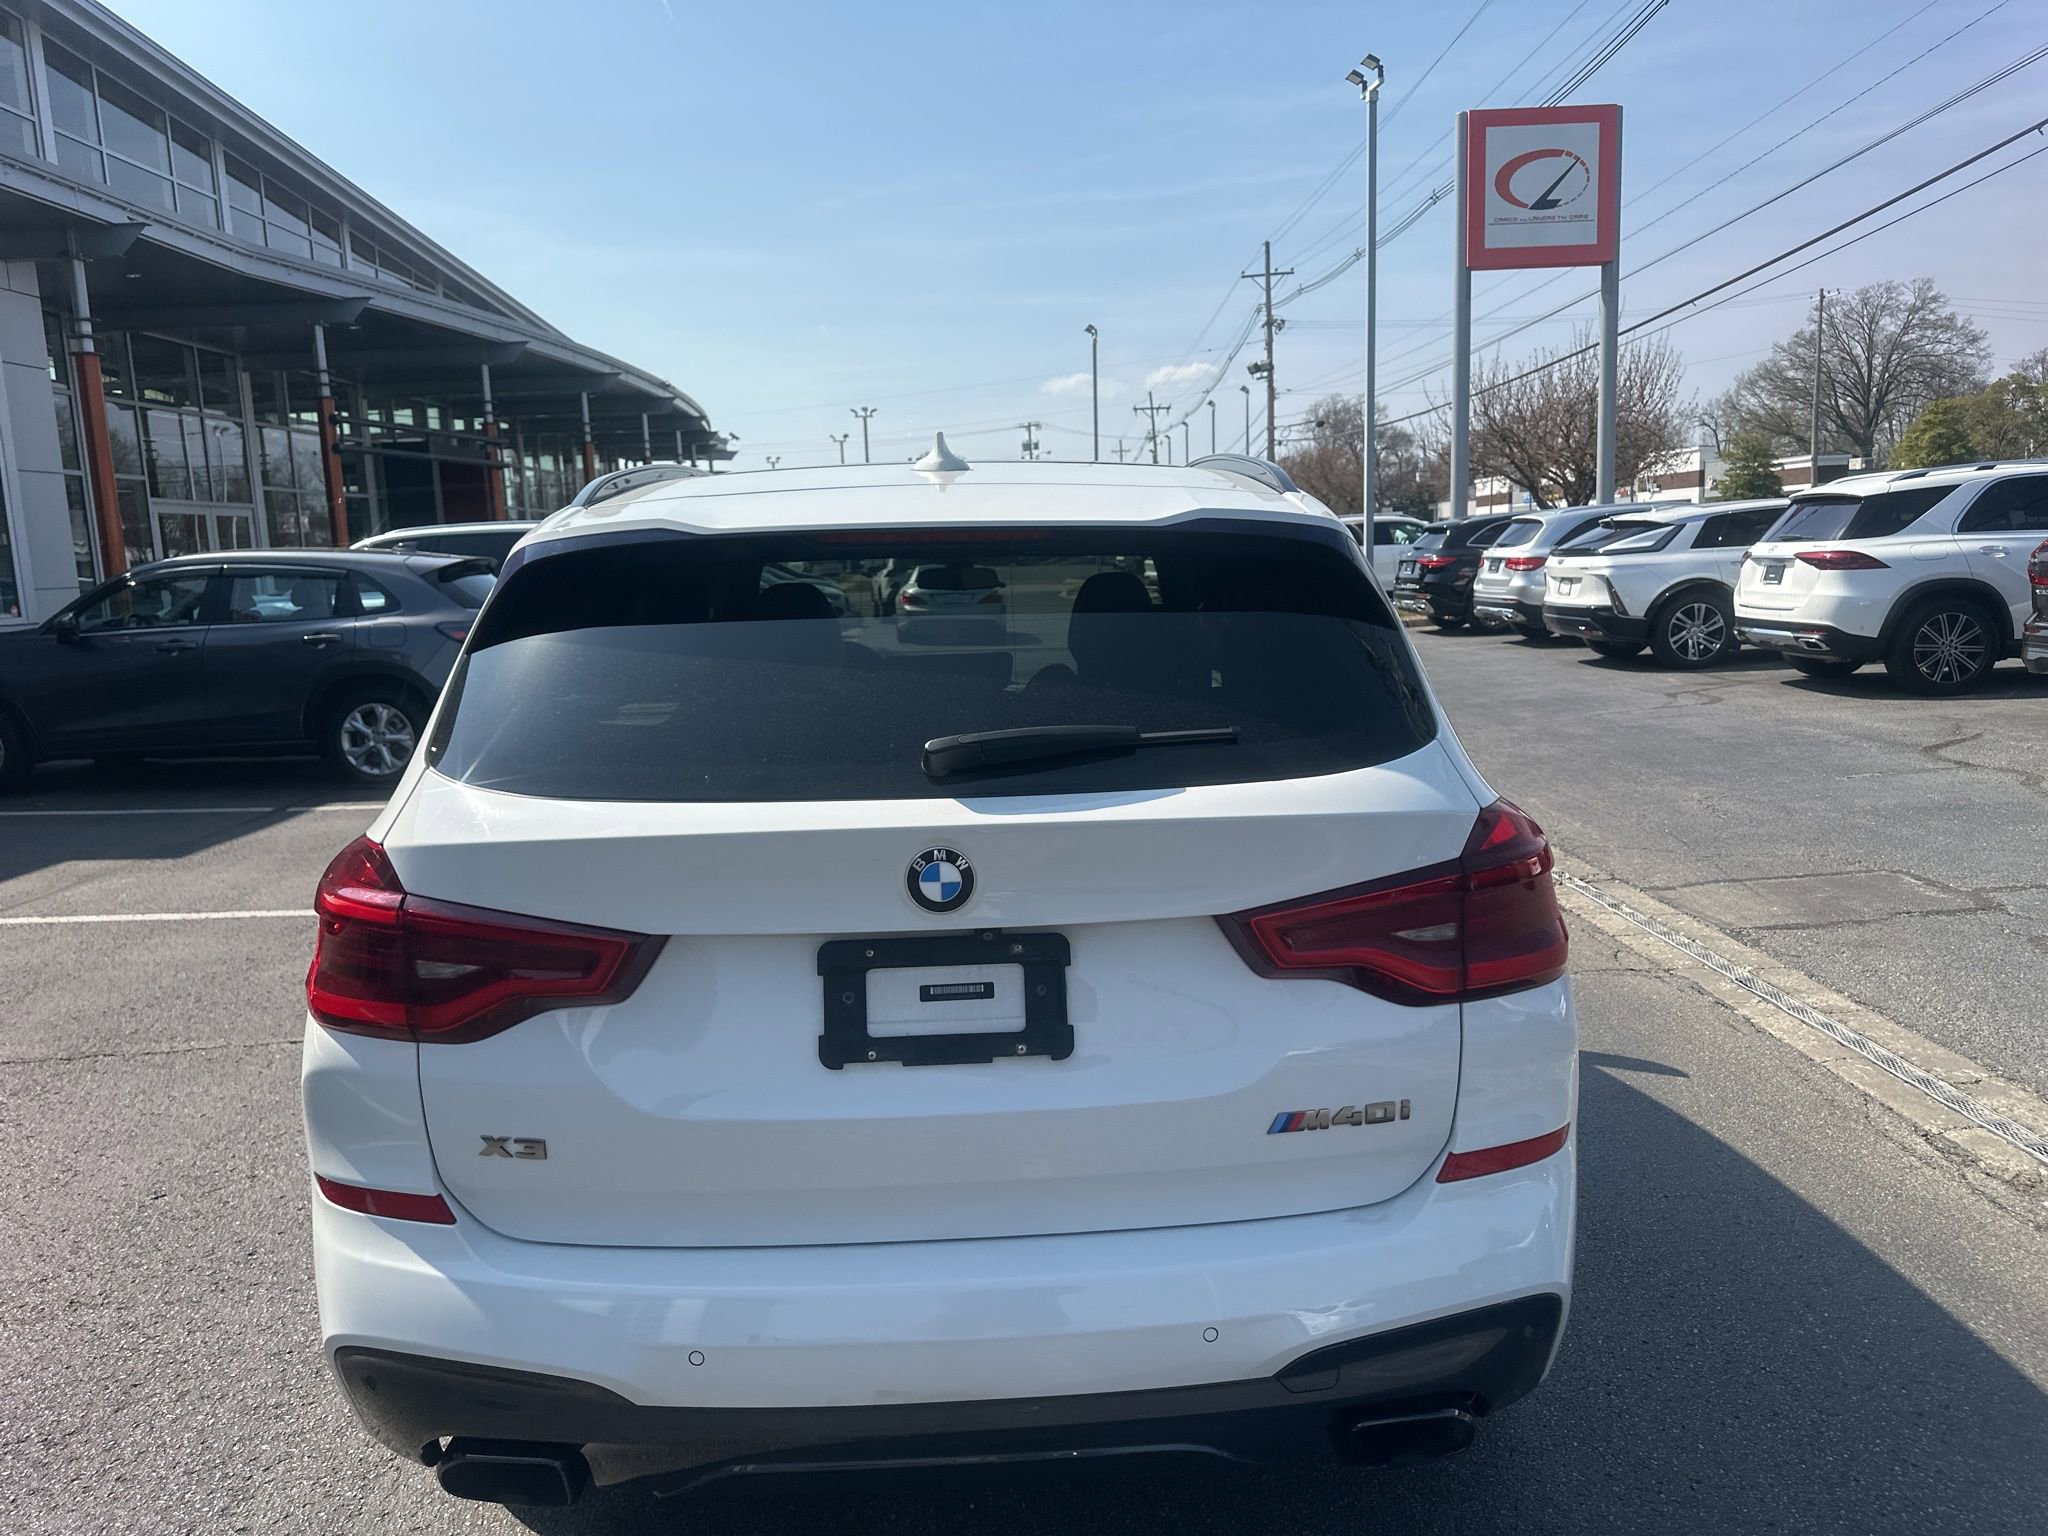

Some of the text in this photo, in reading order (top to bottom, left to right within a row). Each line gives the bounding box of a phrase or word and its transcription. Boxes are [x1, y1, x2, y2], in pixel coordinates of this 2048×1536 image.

[912, 849, 969, 872] BMW
[1298, 1099, 1411, 1131] M40i
[479, 1135, 548, 1160] X3
